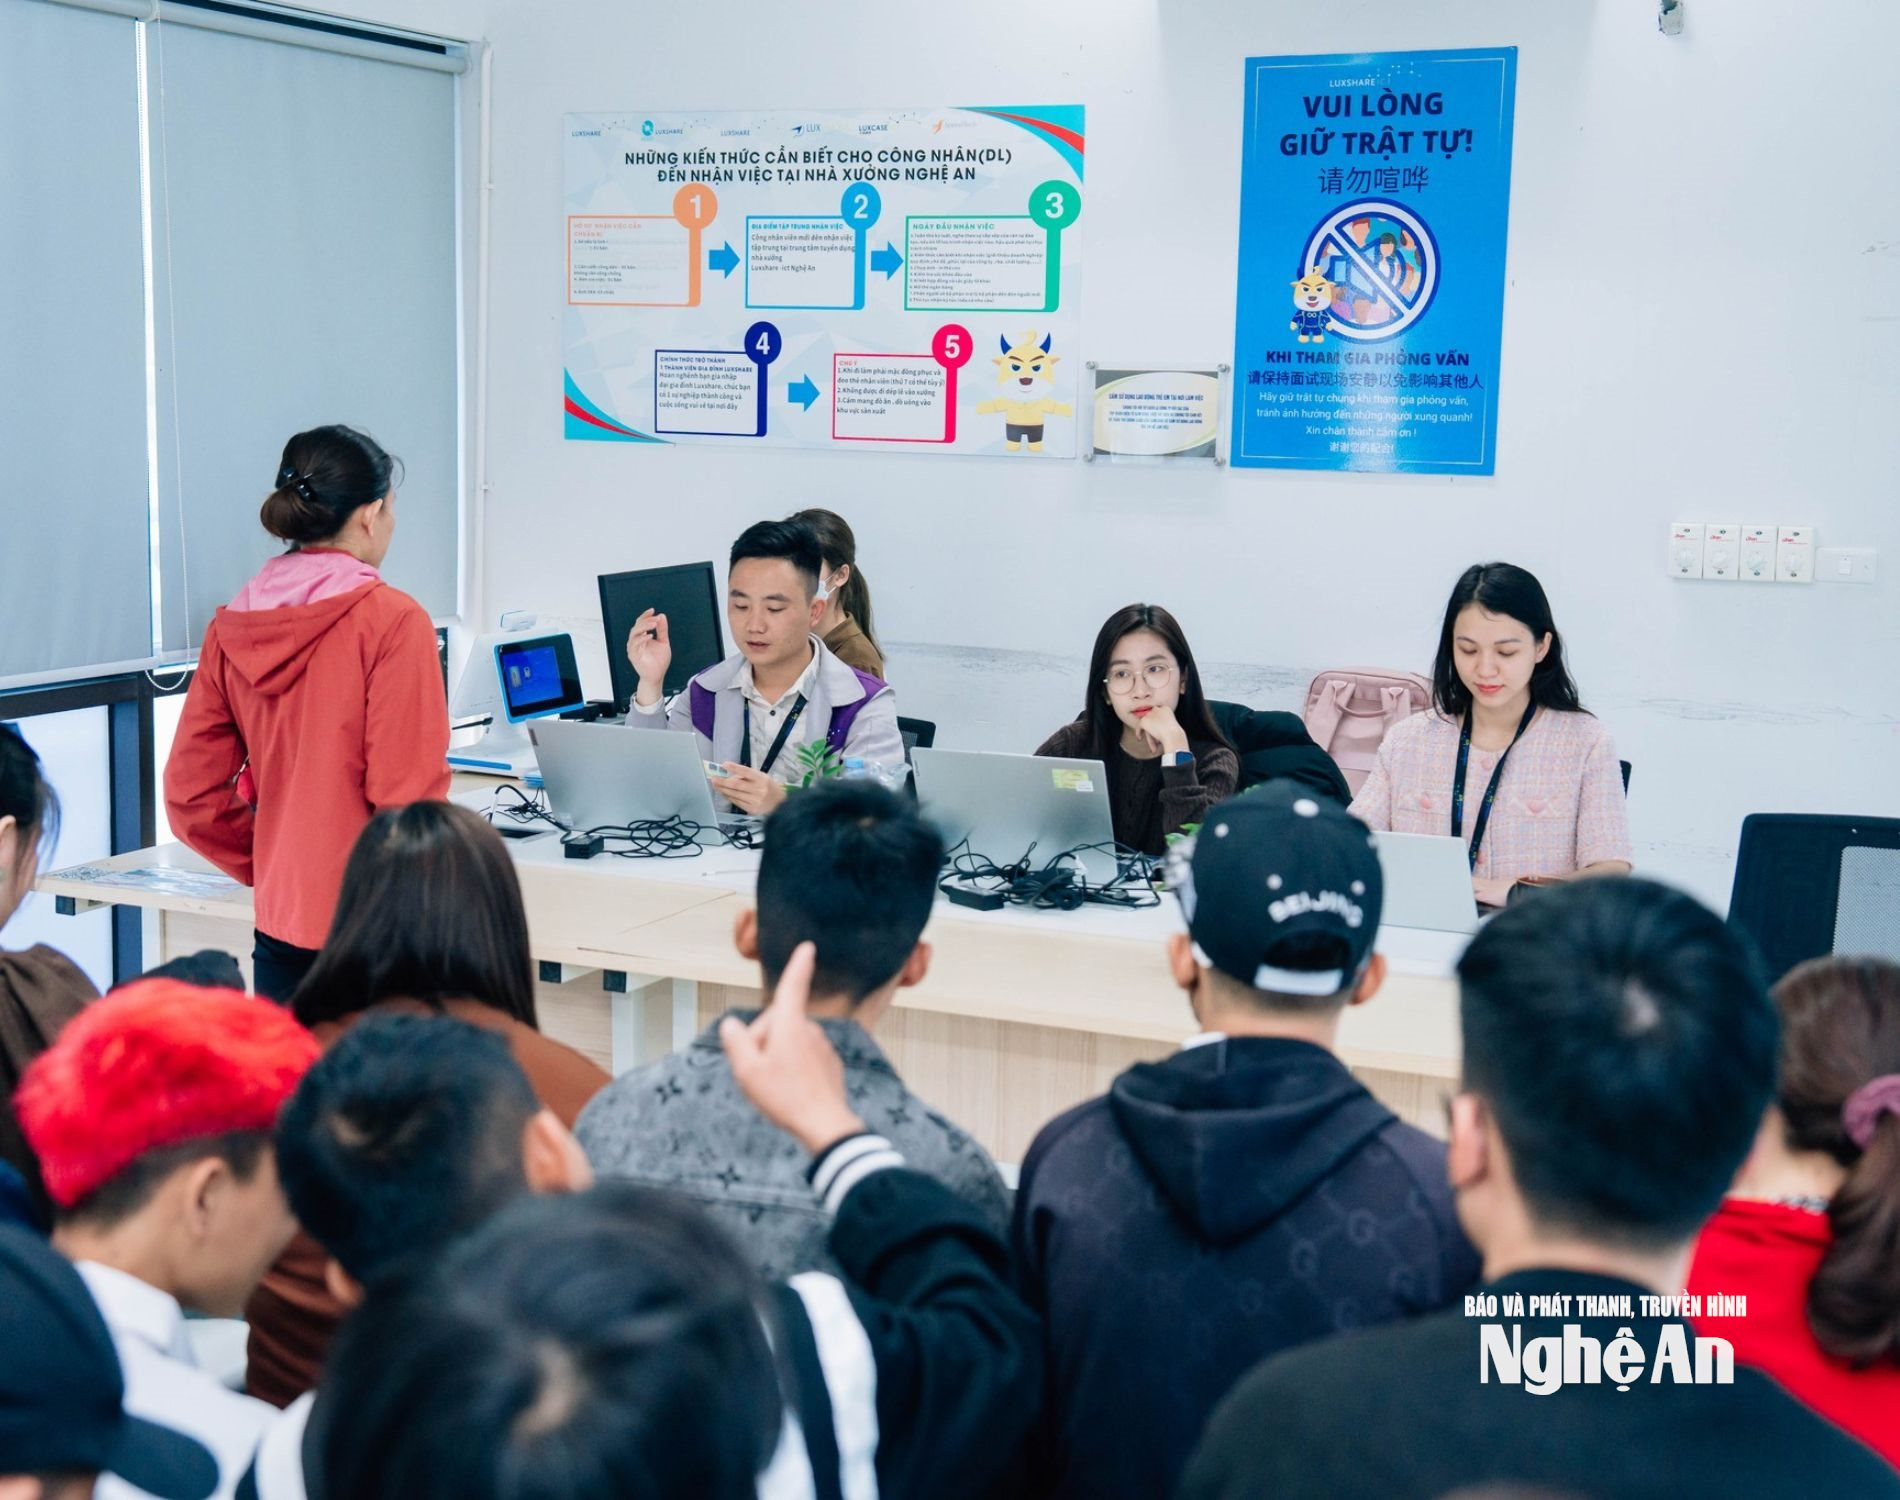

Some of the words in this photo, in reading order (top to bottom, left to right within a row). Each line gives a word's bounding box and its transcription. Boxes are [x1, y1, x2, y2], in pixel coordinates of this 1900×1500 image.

[1329, 79, 1376, 88] LUXSHARE
[1302, 95, 1351, 118] VUI
[1361, 87, 1443, 118] LÒNG
[1279, 127, 1335, 156] GIỮ
[1342, 125, 1414, 161] TRẬT
[1423, 128, 1473, 160] TỰ!
[625, 149, 679, 165] NHỮNG
[683, 146, 716, 164] KIẾN
[720, 148, 760, 164] THỨC
[803, 145, 833, 164] BIẾT
[837, 150, 872, 163] CHO
[878, 146, 926, 162] CÔNG
[658, 165, 686, 182] ĐẾN
[690, 166, 733, 186] NHẬN
[738, 166, 772, 186] VIỆC
[777, 169, 800, 186] TẠI
[804, 165, 838, 182] NHÀ
[842, 164, 900, 181] XƯỞNG
[904, 164, 949, 184] NGHỆ
[953, 167, 976, 180] AN
[1318, 166, 1430, 194] 请勿喧哗
[690, 194, 700, 219] 1
[854, 194, 868, 219] 2
[1044, 192, 1064, 219] 3
[756, 332, 770, 355] 4
[944, 334, 960, 359] 5
[1266, 351, 1292, 364] KHI
[1296, 351, 1340, 364] THAM
[1344, 352, 1370, 365] GIA
[1436, 348, 1470, 366] VẤN
[1248, 370, 1484, 390] 请保持面试现场安静以免影响其他人
[1259, 392, 1277, 402] Hãy
[1280, 392, 1294, 403] giữ
[1326, 393, 1356, 405] chung
[1400, 396, 1415, 406] gia
[1414, 412, 1438, 424] xung
[1306, 426, 1320, 434] Xin
